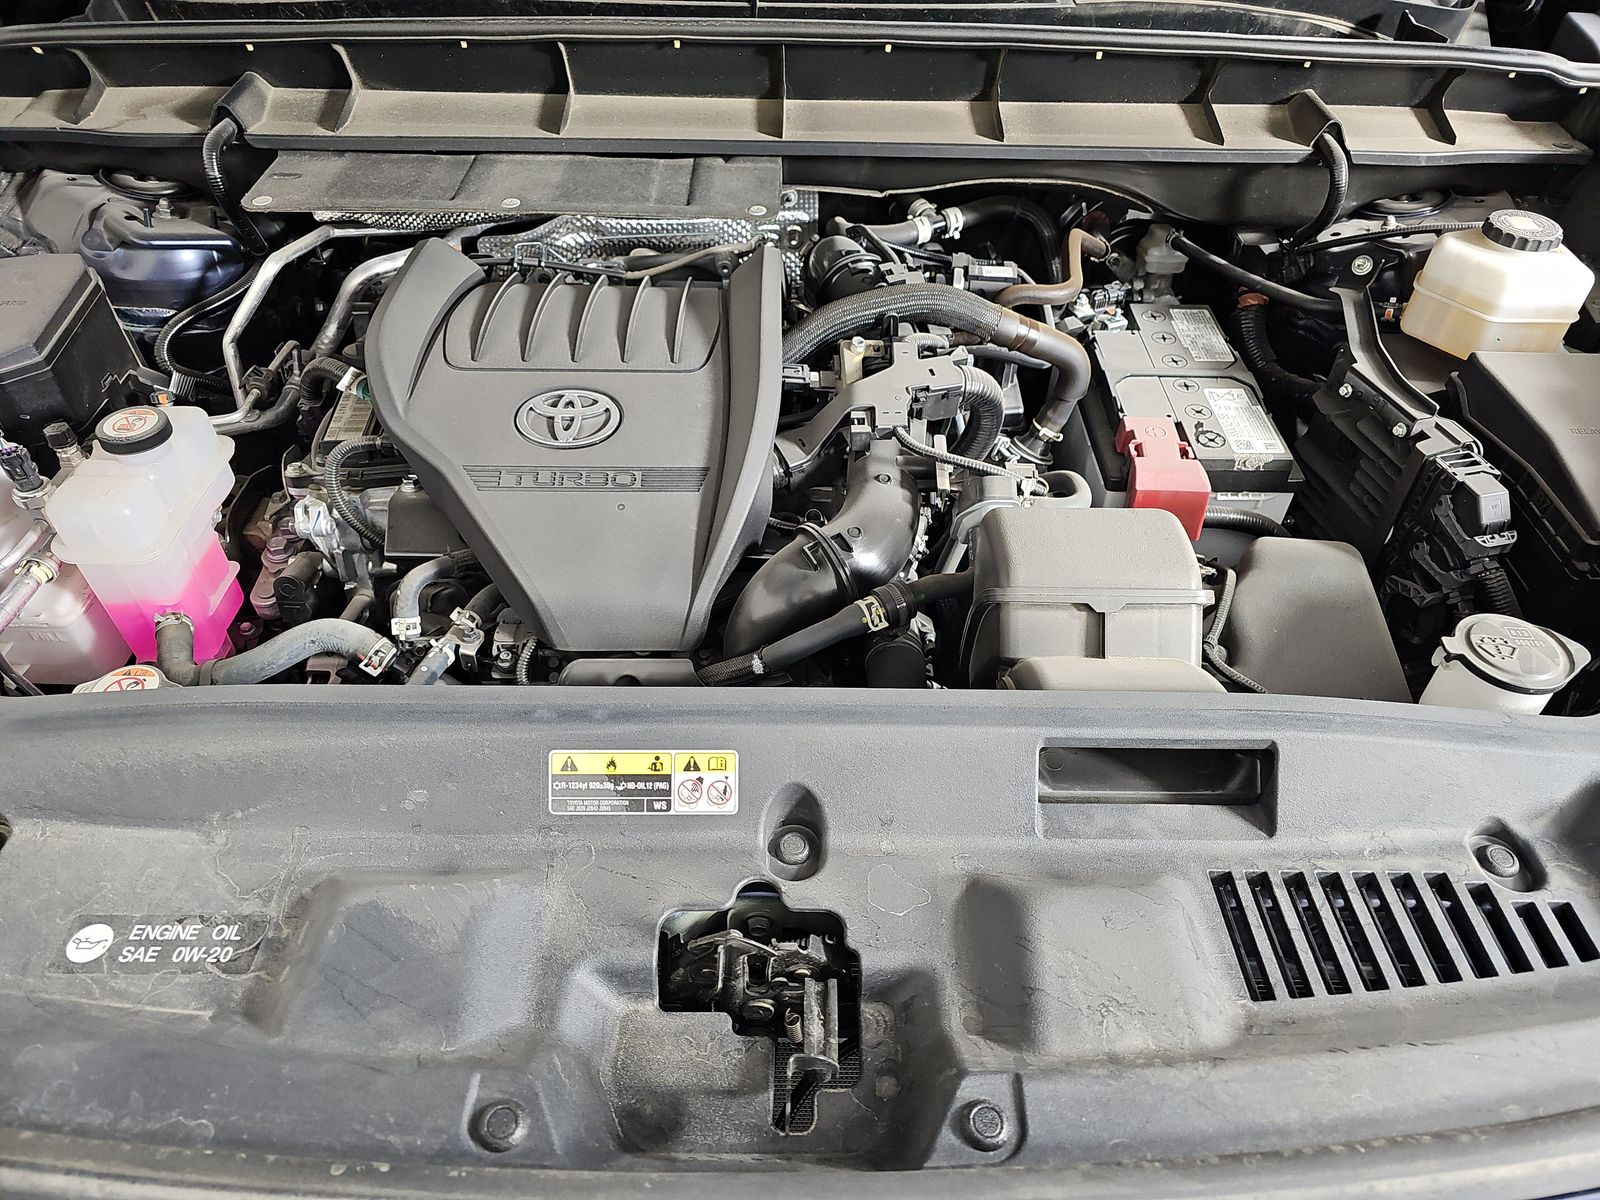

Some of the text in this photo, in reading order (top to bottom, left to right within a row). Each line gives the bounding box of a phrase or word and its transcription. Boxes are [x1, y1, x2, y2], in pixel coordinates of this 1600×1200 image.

[506, 470, 638, 487] TURBO
[561, 781, 588, 791] R-1234yf
[653, 781, 670, 791] (PAG)
[653, 800, 667, 810] WS
[128, 924, 242, 941] ENGINE OIL
[118, 946, 234, 963] SAE 0W-20
